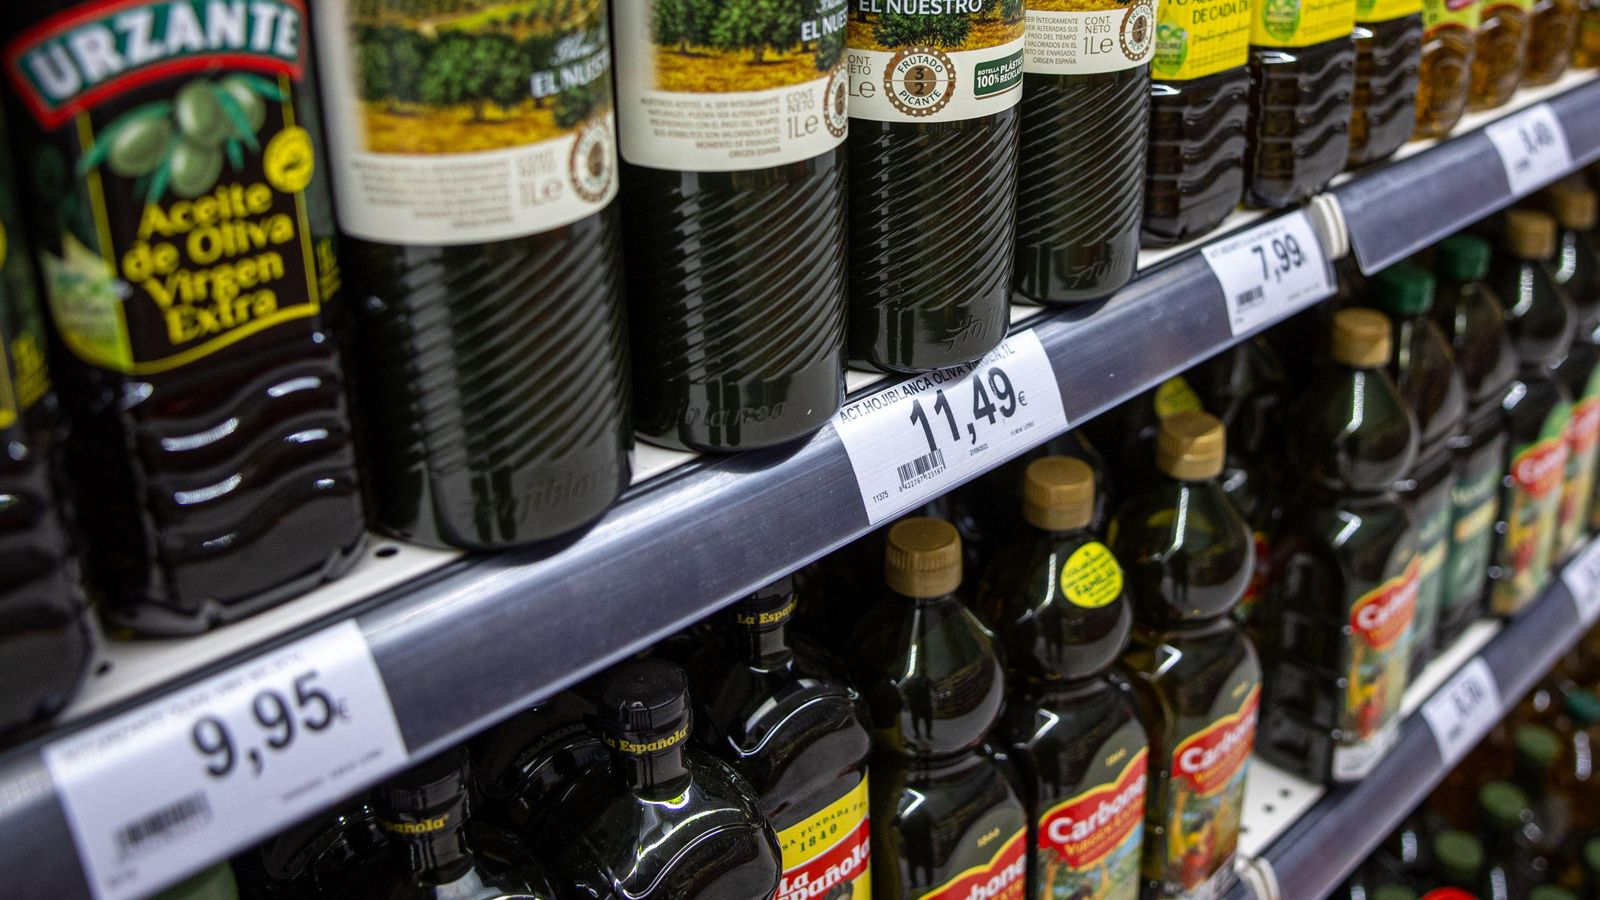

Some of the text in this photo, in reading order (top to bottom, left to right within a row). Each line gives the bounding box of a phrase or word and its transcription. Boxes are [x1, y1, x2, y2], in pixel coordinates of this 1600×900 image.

[859, 0, 882, 13] EL
[886, 0, 982, 15] NUESTRO
[801, 20, 821, 41] EL
[1085, 25, 1111, 34] NETO
[27, 1, 299, 98] URZANTE
[1055, 57, 1077, 65] ESPAÑA
[898, 55, 943, 73] FRUTADO
[915, 67, 924, 80] 3
[977, 67, 1000, 76] BOTELLA
[915, 82, 924, 95] 2
[977, 73, 1000, 89] 100%
[898, 90, 942, 106] PICANTE
[138, 183, 273, 239] Aceite
[122, 213, 294, 282] de Oliva
[1252, 234, 1302, 283] 7,99
[143, 252, 285, 307] Virgen
[166, 288, 278, 345] Extra
[839, 376, 935, 424] ACT.HOJIBLANCA
[932, 364, 966, 385] OLIVA
[909, 366, 1028, 454] 11,49 €
[872, 490, 889, 504] 11375
[191, 671, 337, 778] 9,95
[619, 724, 688, 756] Española
[800, 808, 849, 838] FUNDADA
[800, 823, 838, 852] 1840
[780, 871, 809, 898] La
